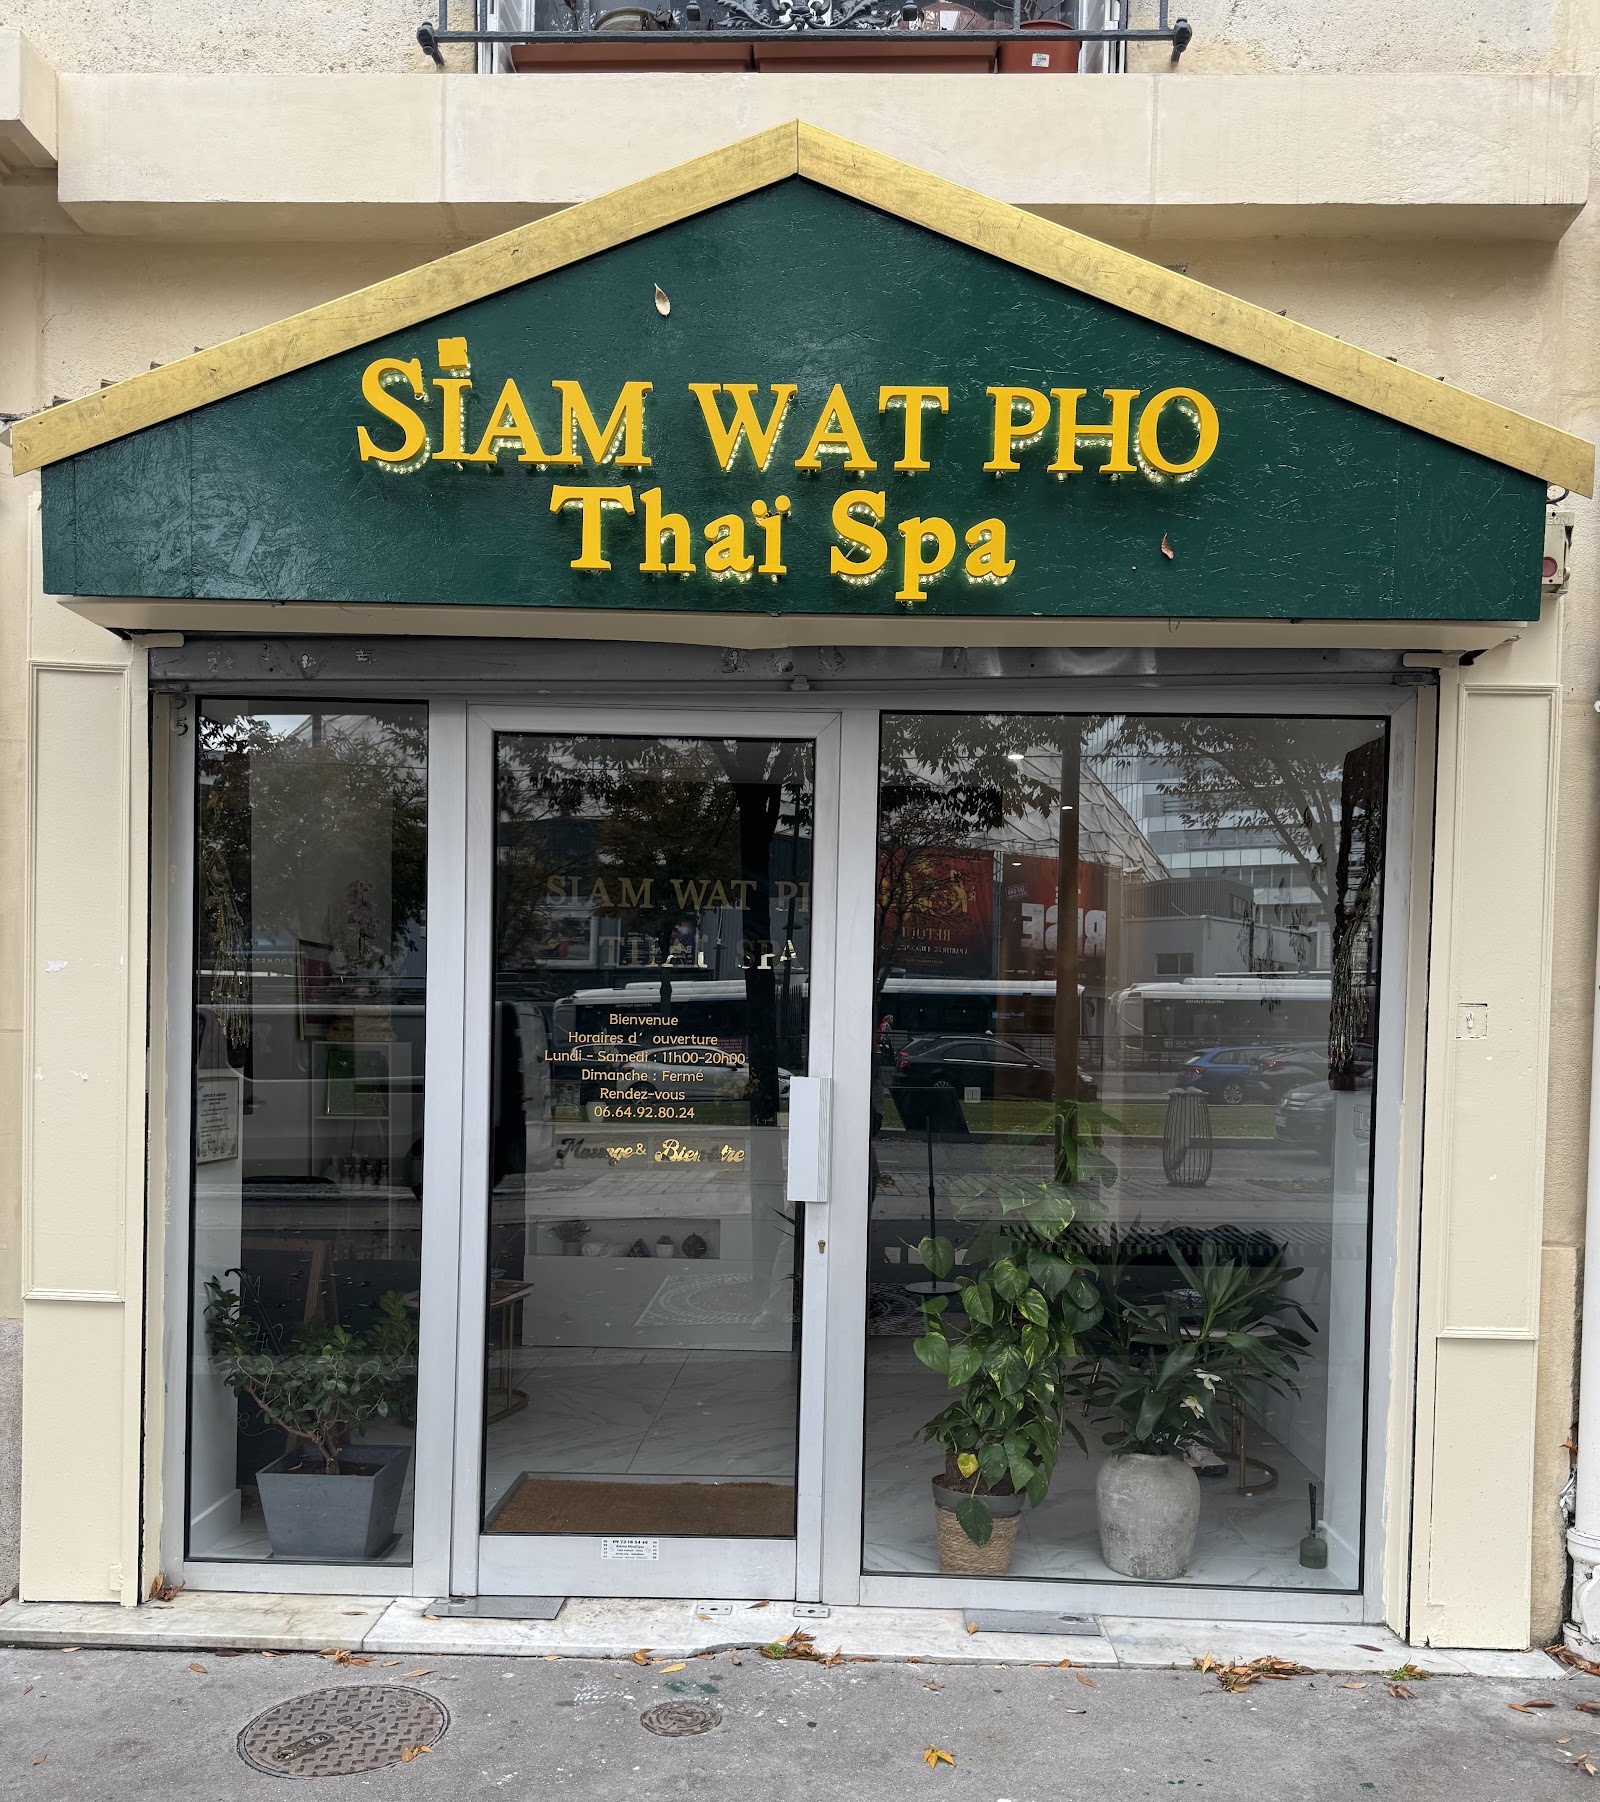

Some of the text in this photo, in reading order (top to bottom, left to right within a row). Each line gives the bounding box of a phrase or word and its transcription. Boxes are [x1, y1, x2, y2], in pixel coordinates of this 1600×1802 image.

[689, 384, 948, 469] WAT
[984, 387, 1219, 474] PHO
[550, 485, 1015, 600] Thaï Spa
[546, 875, 654, 910] SIAM
[670, 879, 757, 911] WAT
[736, 938, 804, 970] SPA
[609, 1013, 679, 1027] Bienvenue
[568, 1031, 624, 1045] Horaires
[652, 1034, 718, 1047] ouverture
[544, 1049, 583, 1063] Lundi
[597, 1051, 649, 1064] Samedi
[662, 1051, 746, 1066] 11h00-20h00
[581, 1068, 648, 1082] Dimanche
[661, 1068, 705, 1083] Fermé
[599, 1087, 686, 1101] Rendez-vous
[593, 1106, 696, 1119] 06.64.92.80.24
